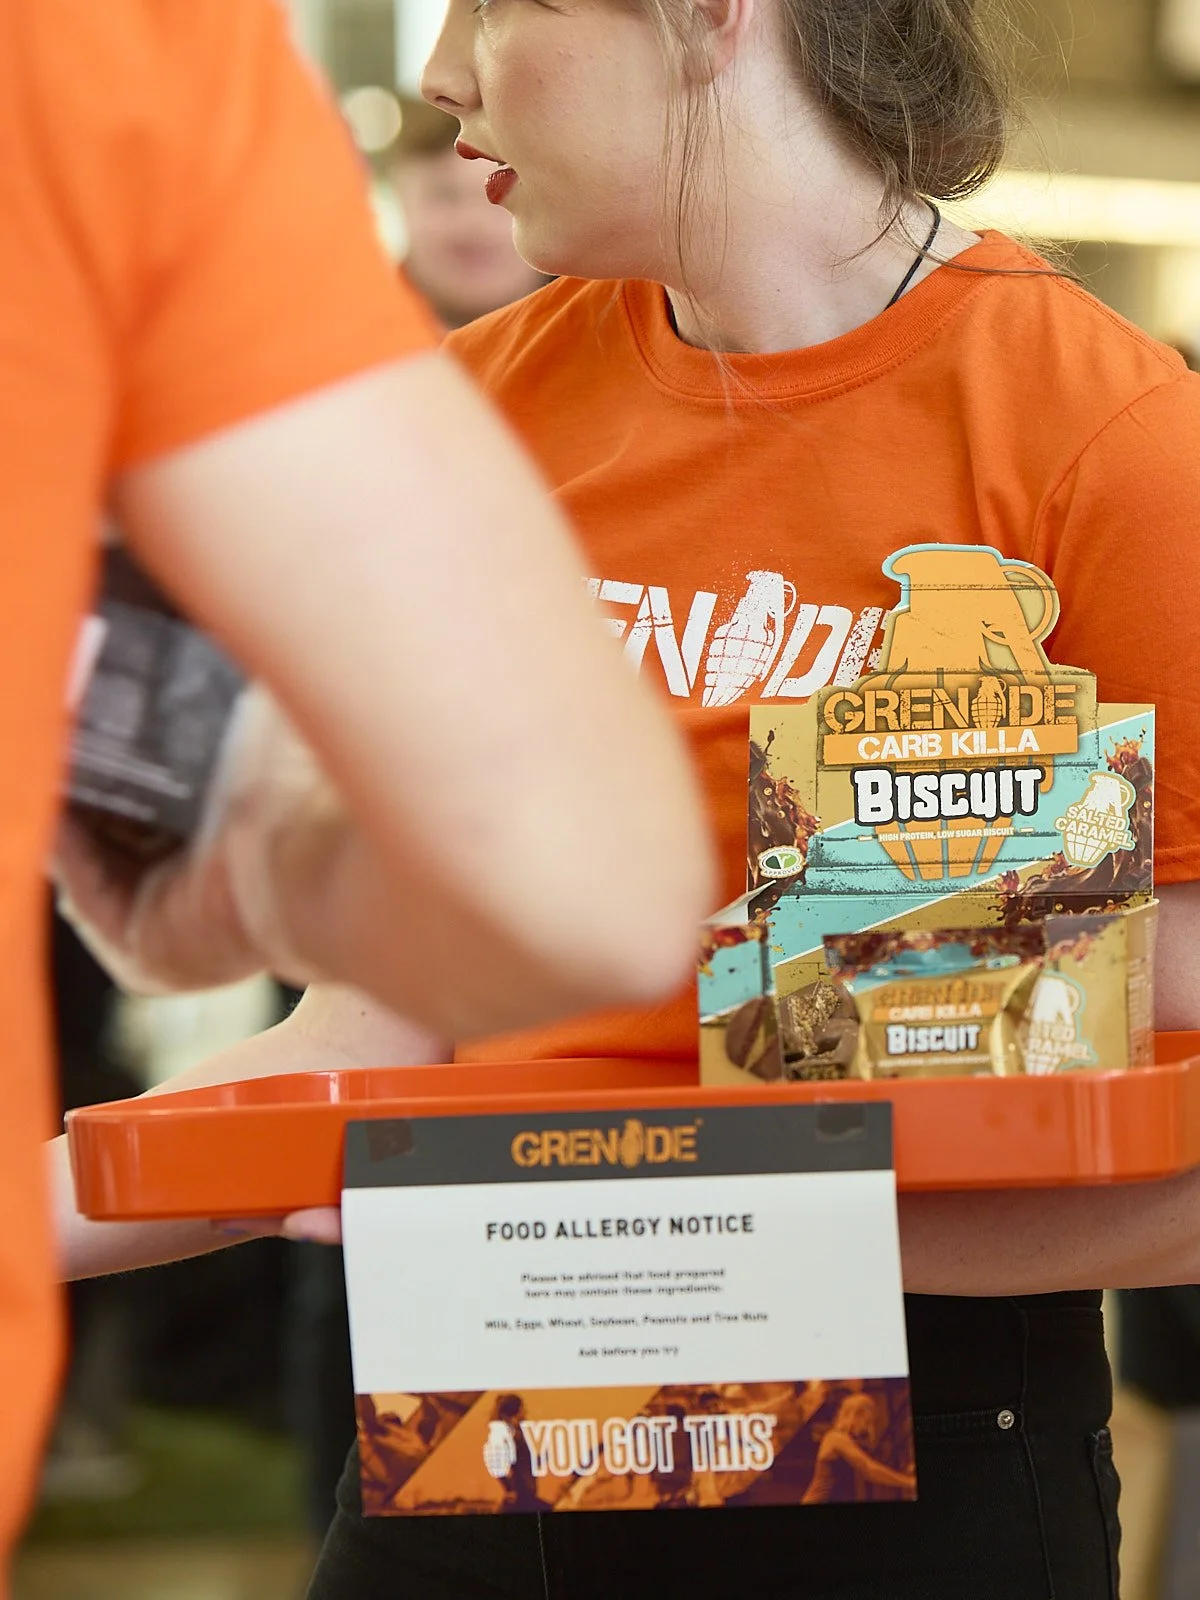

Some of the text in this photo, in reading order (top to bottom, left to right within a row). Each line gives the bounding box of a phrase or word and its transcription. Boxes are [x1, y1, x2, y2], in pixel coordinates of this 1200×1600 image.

[857, 728, 1040, 760] CARB KILLA
[1066, 805, 1127, 831] SALTED
[878, 827, 1015, 842] HIGH PROTEIN, LOW SUGAR BISCUIT
[1055, 817, 1132, 847] CARAMEL
[487, 1214, 755, 1241] FOOD ALLERGY NOTICE
[691, 1314, 710, 1324] and
[520, 1413, 777, 1477] YOU GOT THIS
